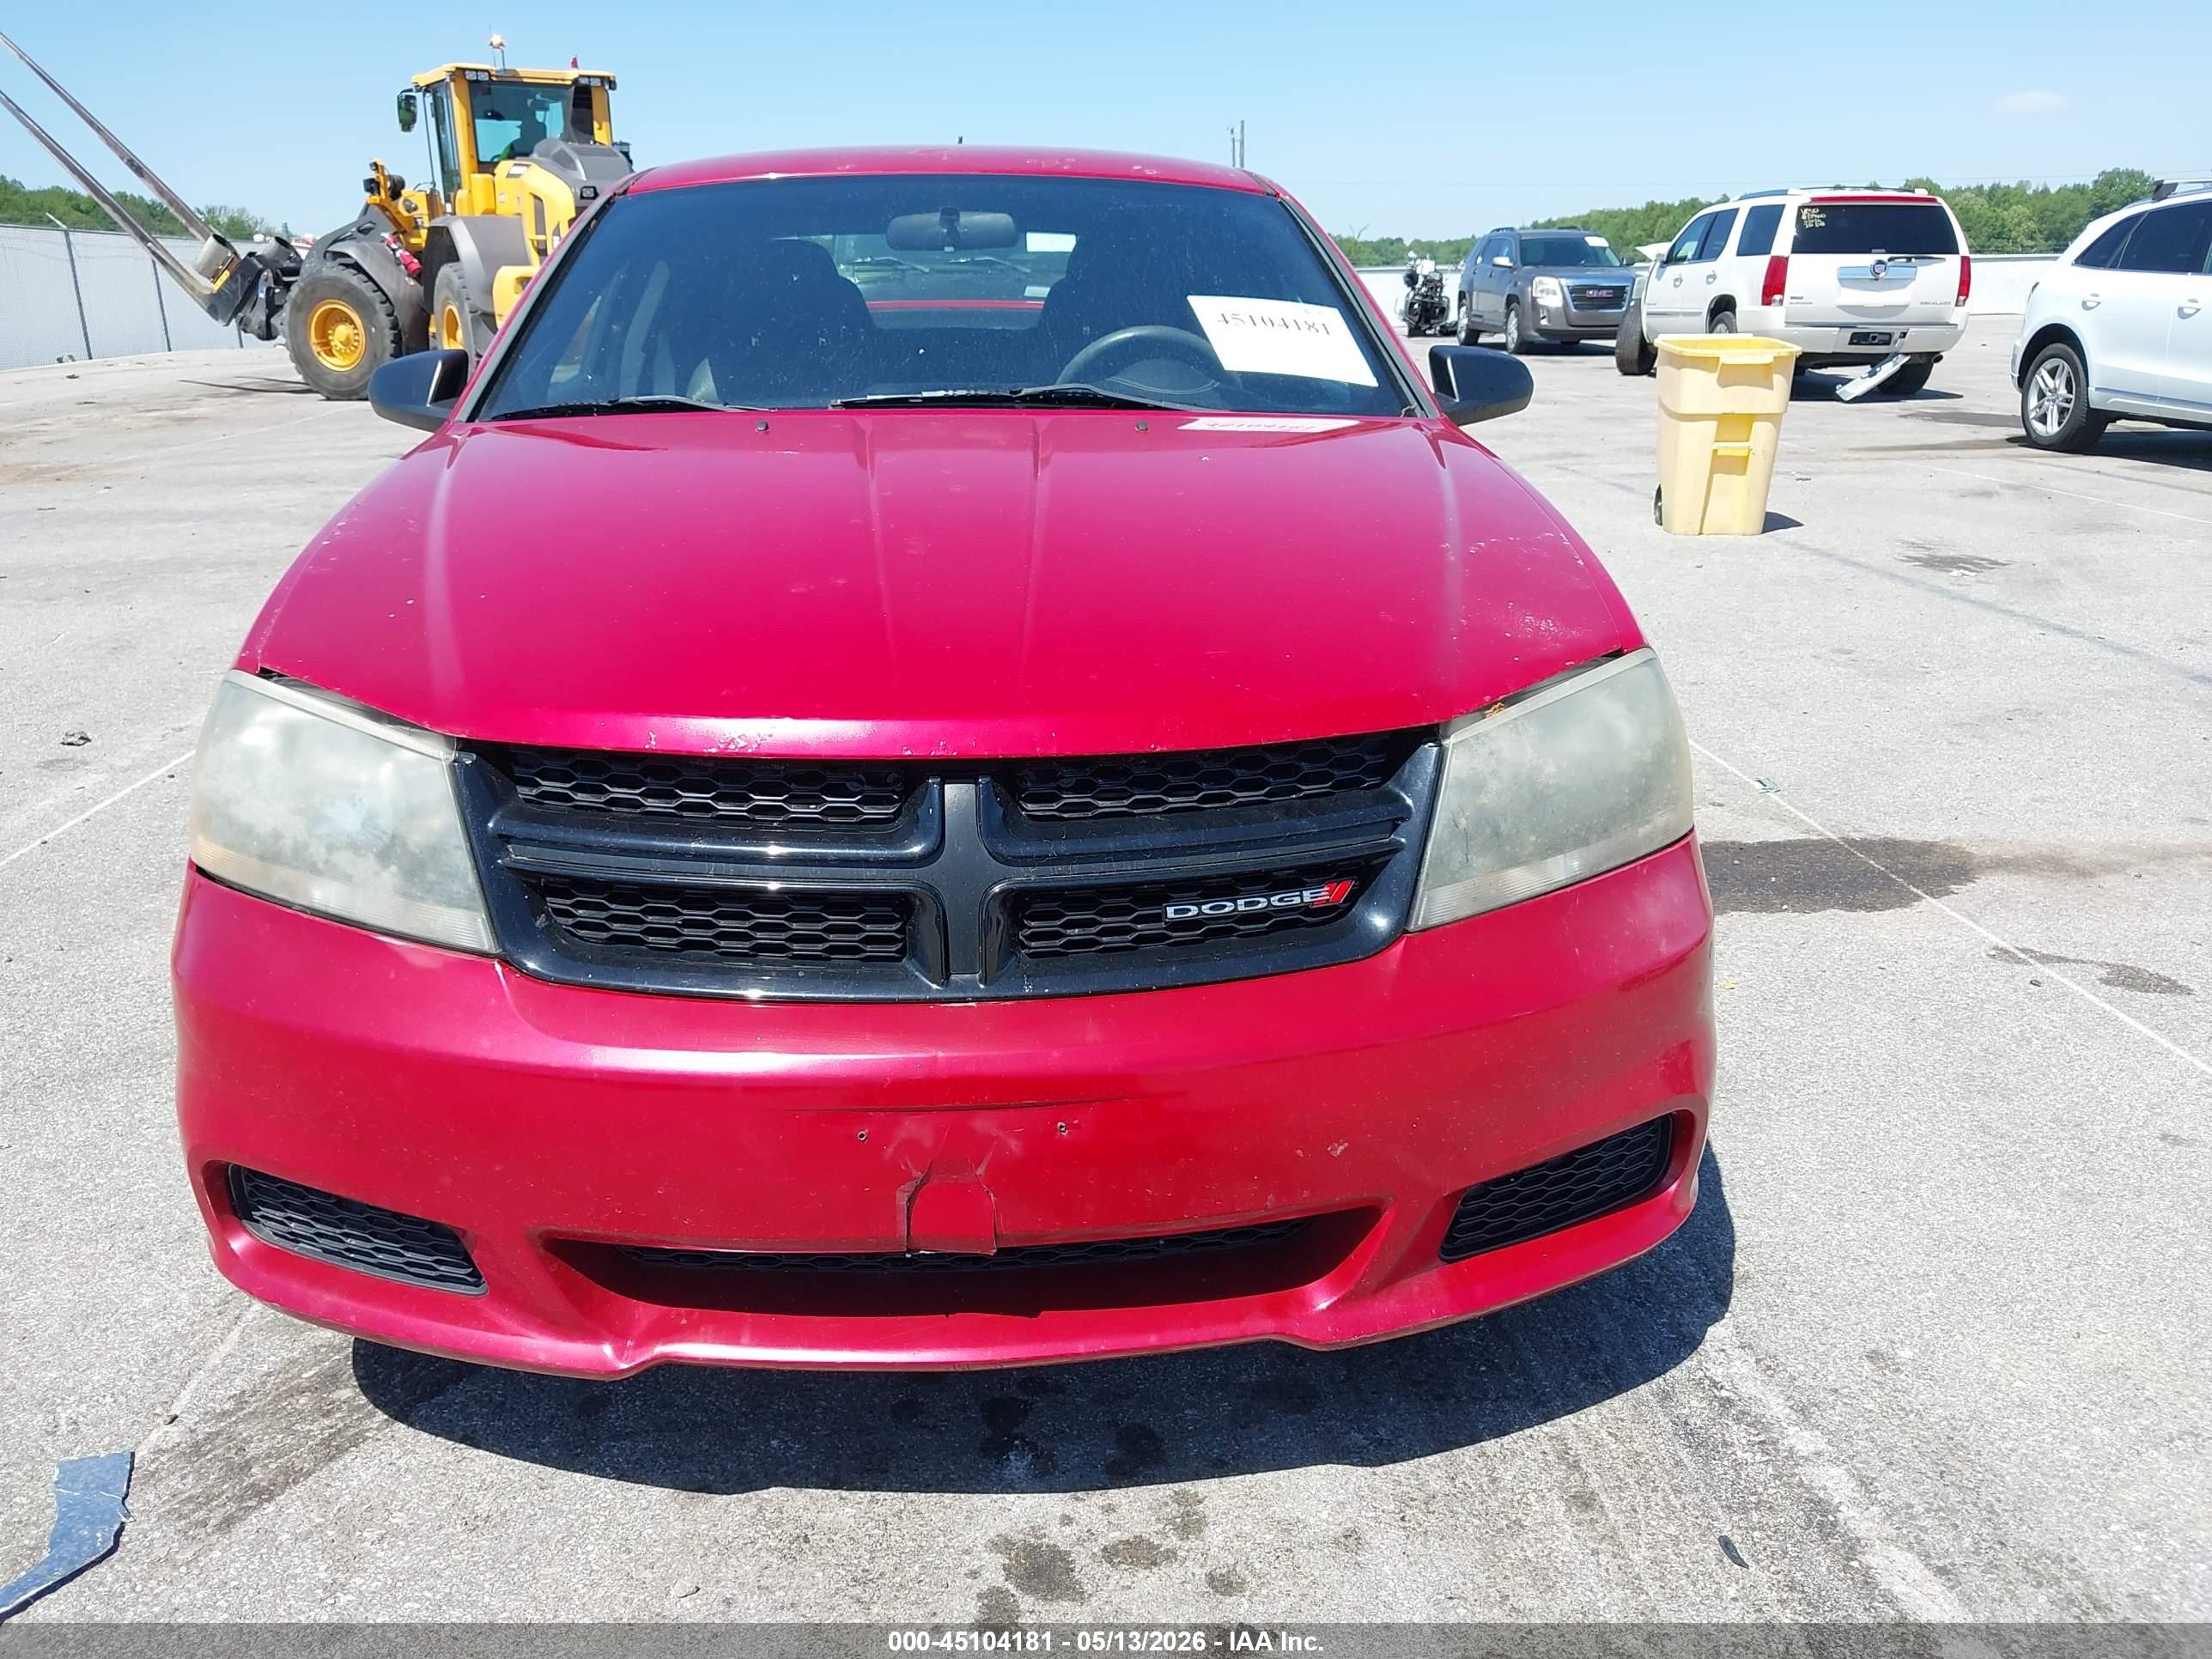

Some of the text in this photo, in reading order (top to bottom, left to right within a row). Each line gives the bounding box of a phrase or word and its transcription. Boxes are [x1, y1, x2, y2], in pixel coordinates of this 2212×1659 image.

[1586, 289, 1613, 297] GMC
[1216, 312, 1331, 336] 45104181
[1165, 887, 1332, 919] DODGE
